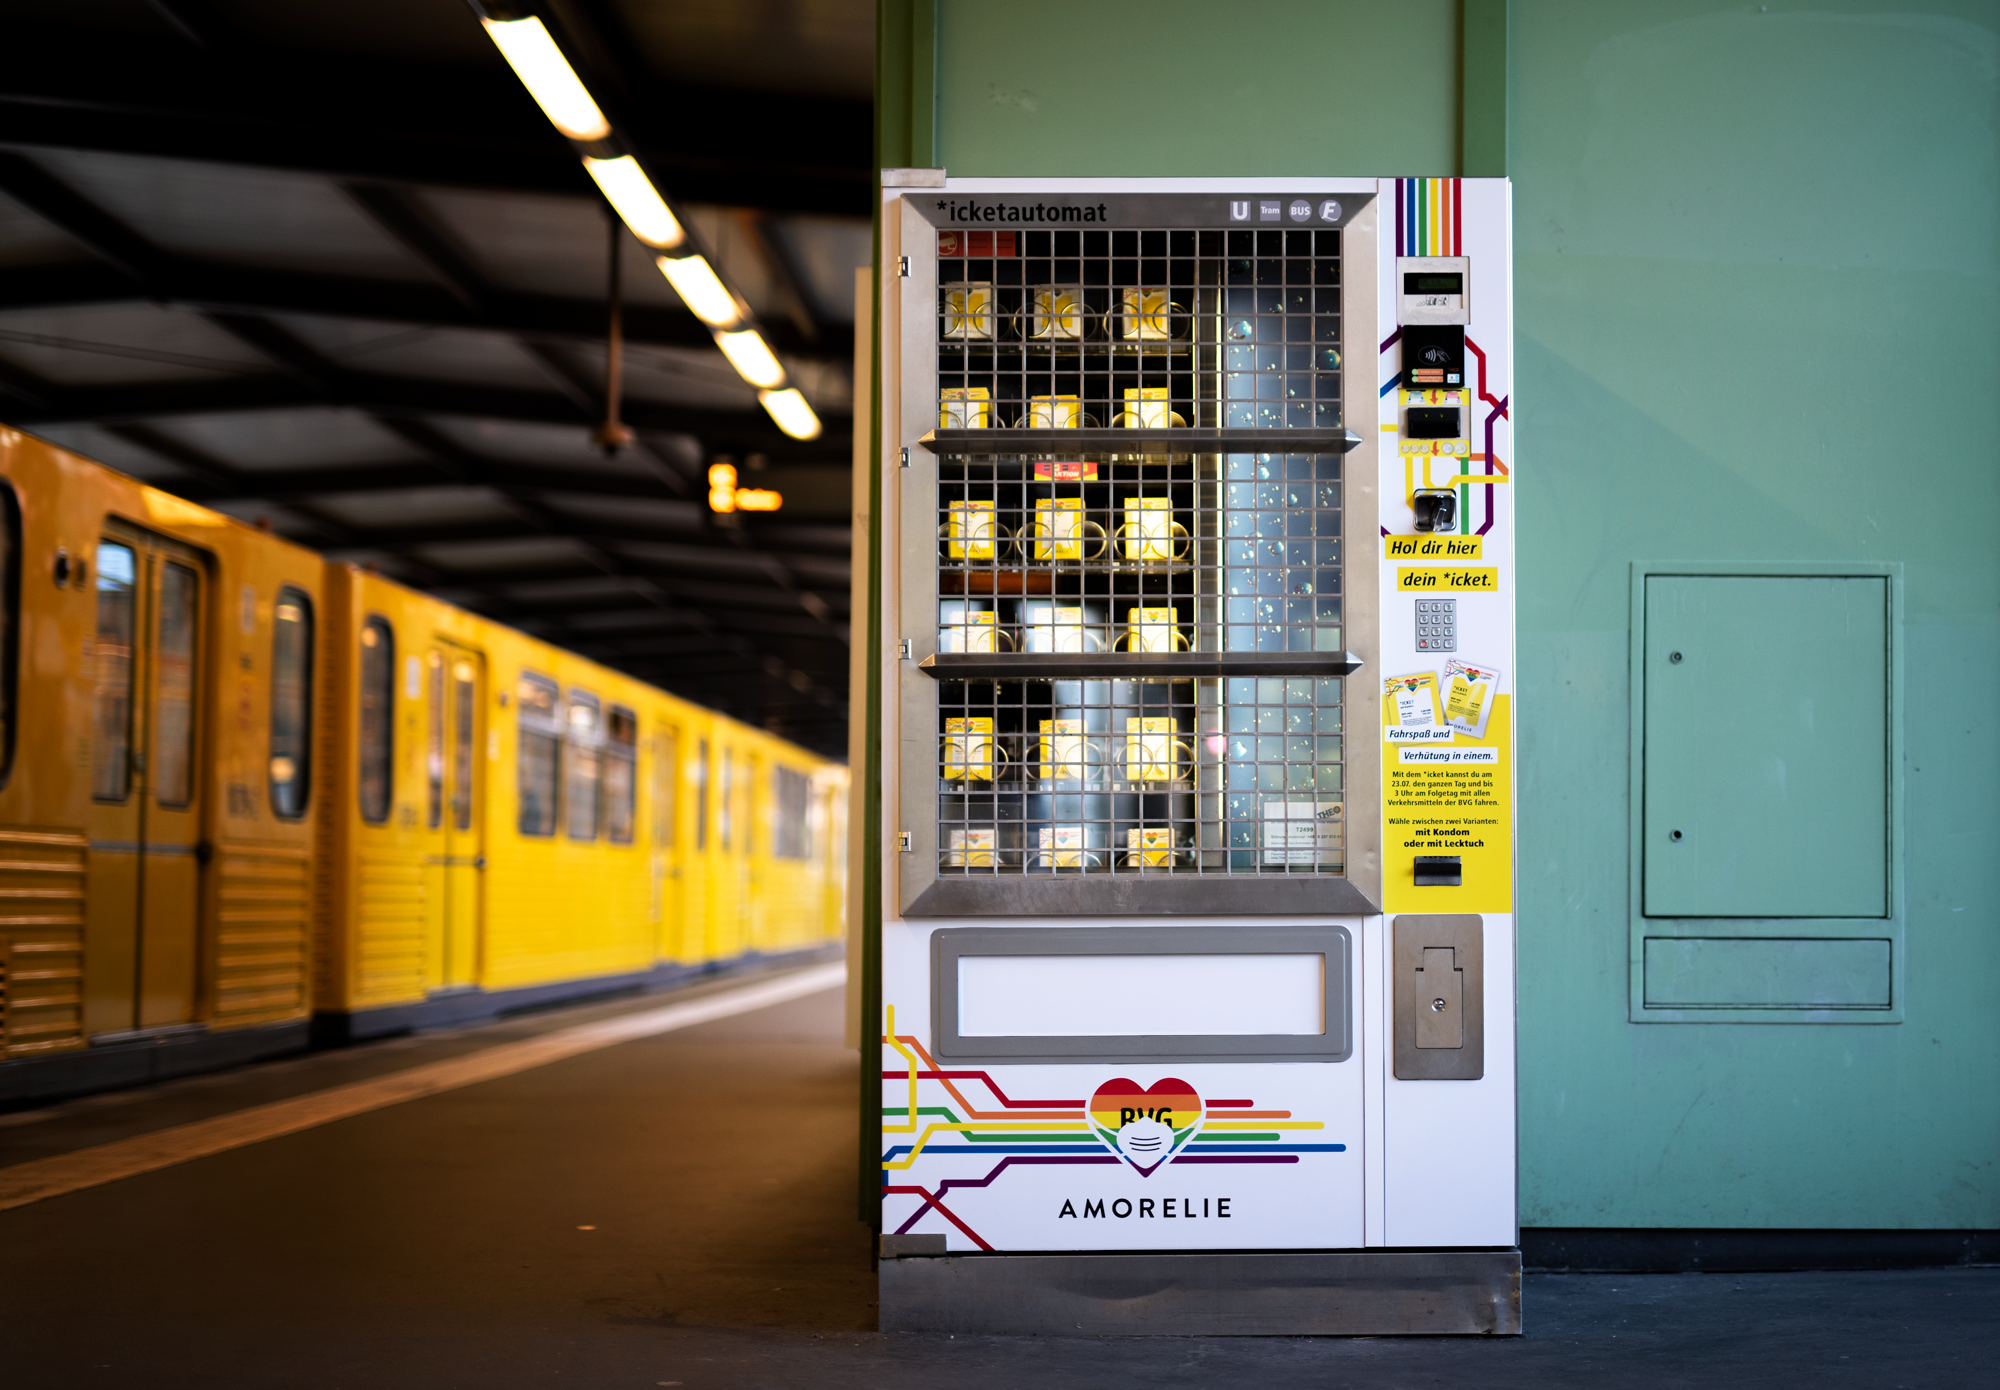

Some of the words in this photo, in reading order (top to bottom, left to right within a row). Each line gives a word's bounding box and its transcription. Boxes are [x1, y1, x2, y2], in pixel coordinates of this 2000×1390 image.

[1233, 202, 1247, 219] U
[1261, 206, 1280, 214] Tram
[1291, 207, 1310, 215] BUS
[1391, 541, 1417, 554] Hol
[1422, 541, 1443, 554] dir
[1447, 541, 1477, 554] hier
[1404, 572, 1436, 586] dein
[1389, 729, 1430, 740] Fahrspaß
[1433, 729, 1450, 739] und
[1404, 752, 1450, 762] Verhütung
[1453, 752, 1461, 760] in
[1463, 752, 1493, 760] einem.
[1454, 781, 1466, 789] Tag
[1428, 790, 1458, 798] Folgetag
[1058, 1198, 1231, 1218] AMORELIE
